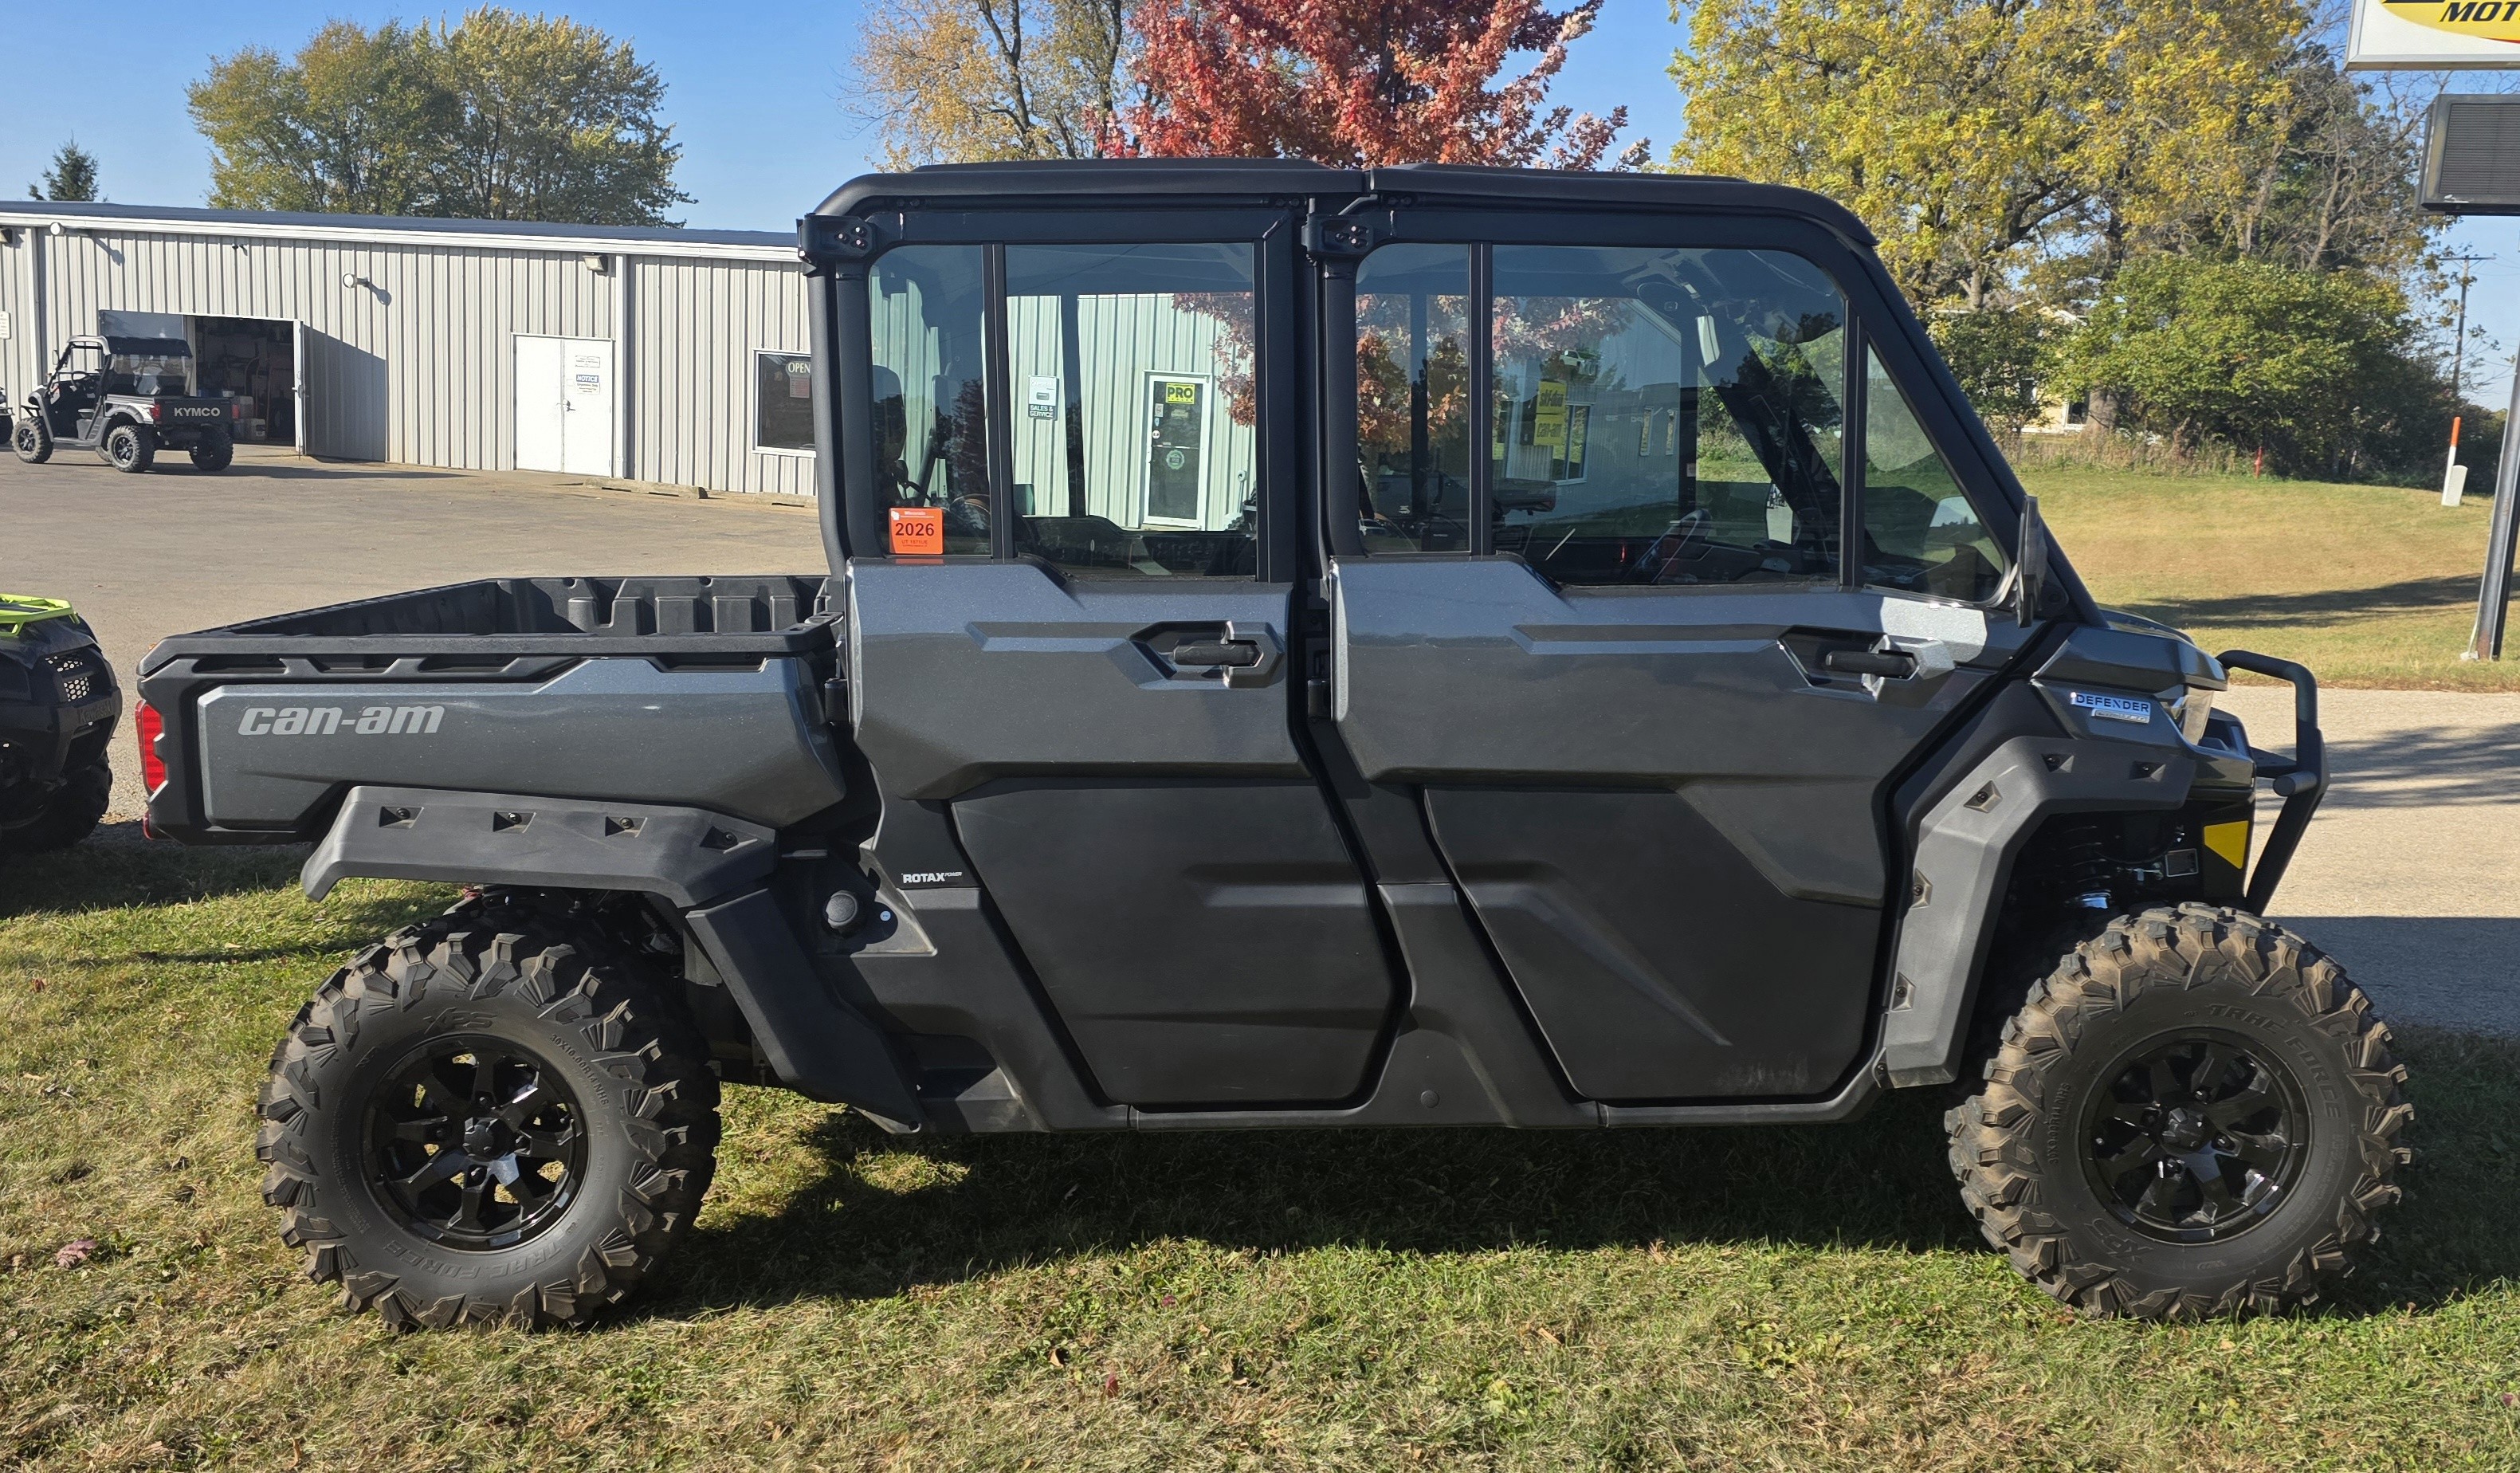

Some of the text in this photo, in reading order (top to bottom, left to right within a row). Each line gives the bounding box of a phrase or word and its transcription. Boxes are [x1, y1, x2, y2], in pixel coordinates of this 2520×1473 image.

[2439, 2, 2520, 22] MOT
[787, 362, 811, 374] OPEN
[1167, 387, 1193, 399] PRO
[174, 407, 221, 417] KYMCO
[895, 522, 935, 536] 2026
[2075, 693, 2149, 713] DEFENDER
[237, 705, 446, 736] can-am
[902, 872, 946, 884] ROTAX
[2205, 1003, 2341, 1118] TRAC FORCE
[383, 1240, 562, 1280] TRAC FORCE
